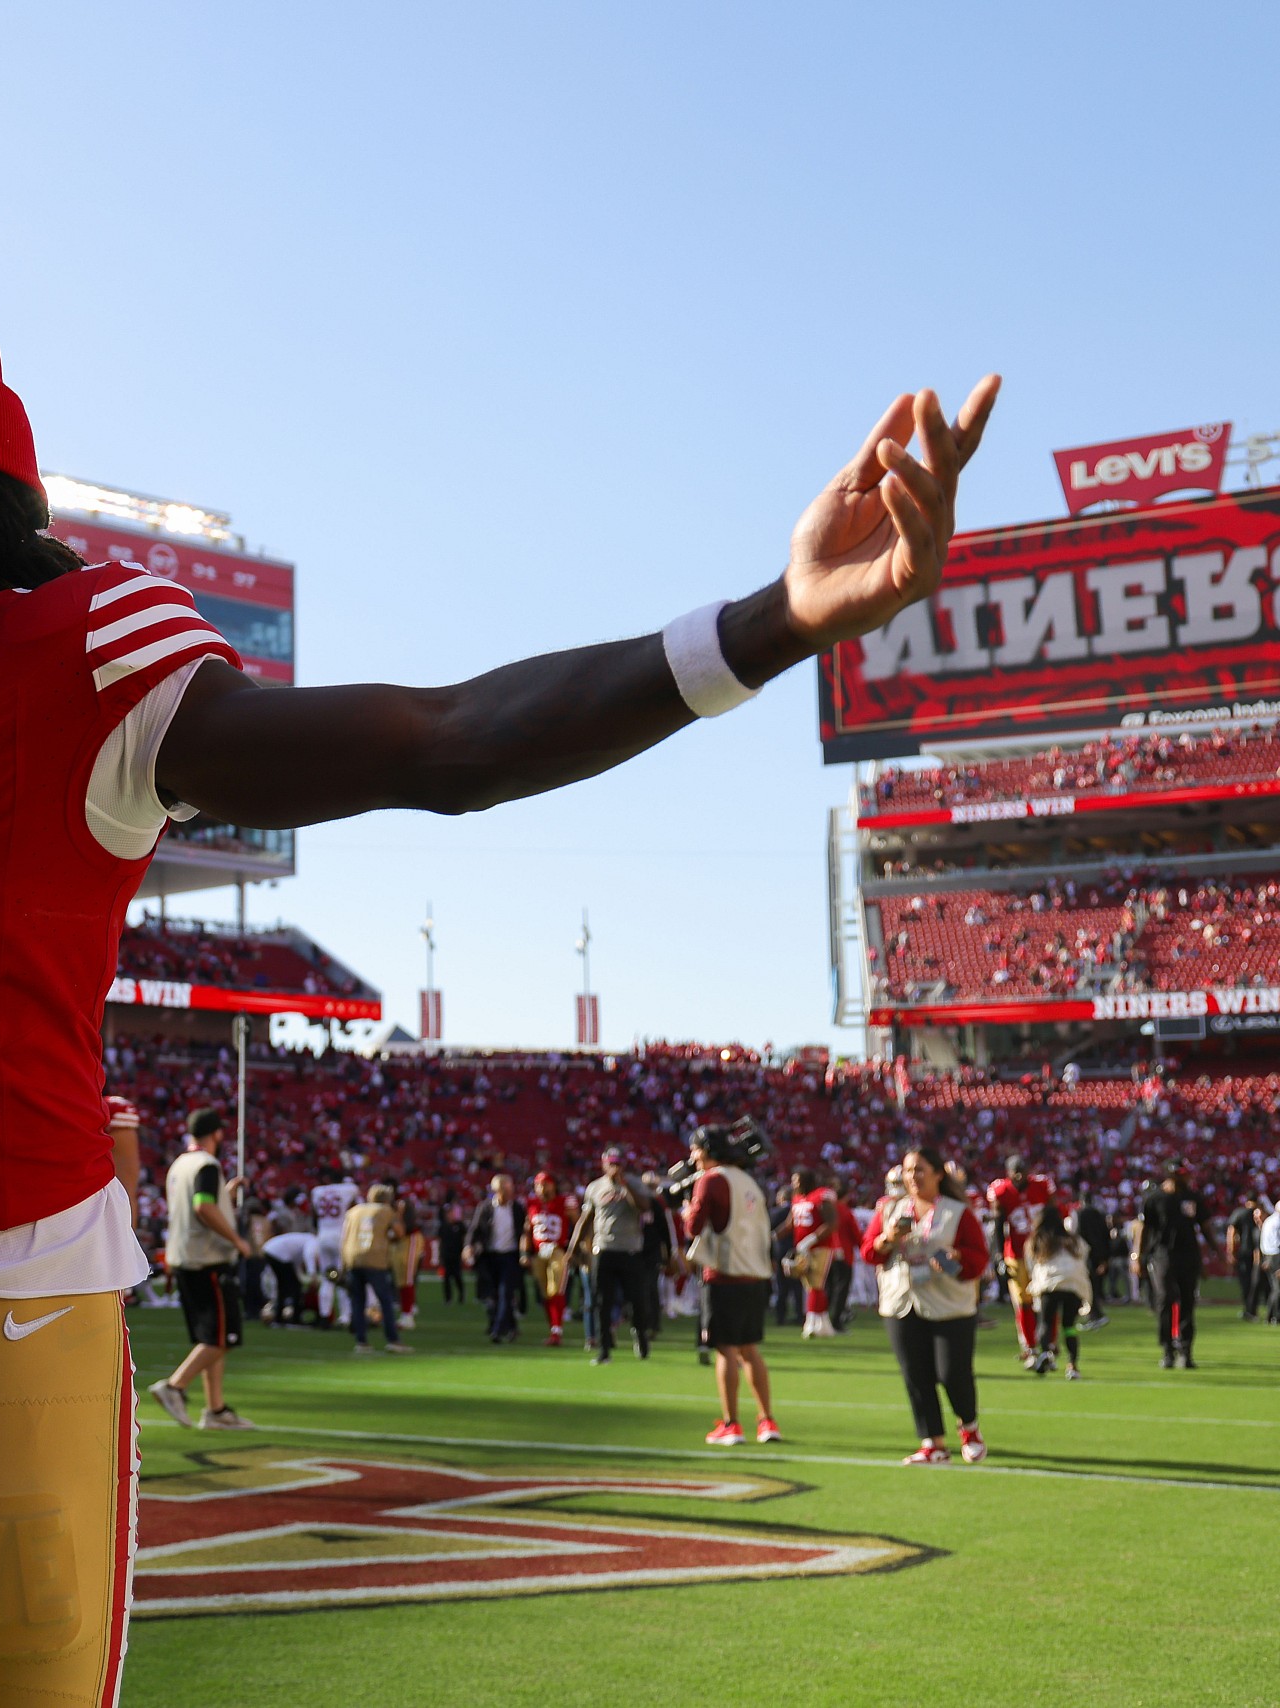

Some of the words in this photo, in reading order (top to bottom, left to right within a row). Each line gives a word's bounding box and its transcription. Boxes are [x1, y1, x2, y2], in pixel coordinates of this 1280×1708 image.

[951, 800, 1028, 824] NINERS
[1031, 796, 1076, 817] WIN
[138, 979, 192, 1009] WIN
[1092, 991, 1208, 1020] NINERS
[1212, 987, 1280, 1015] WIN
